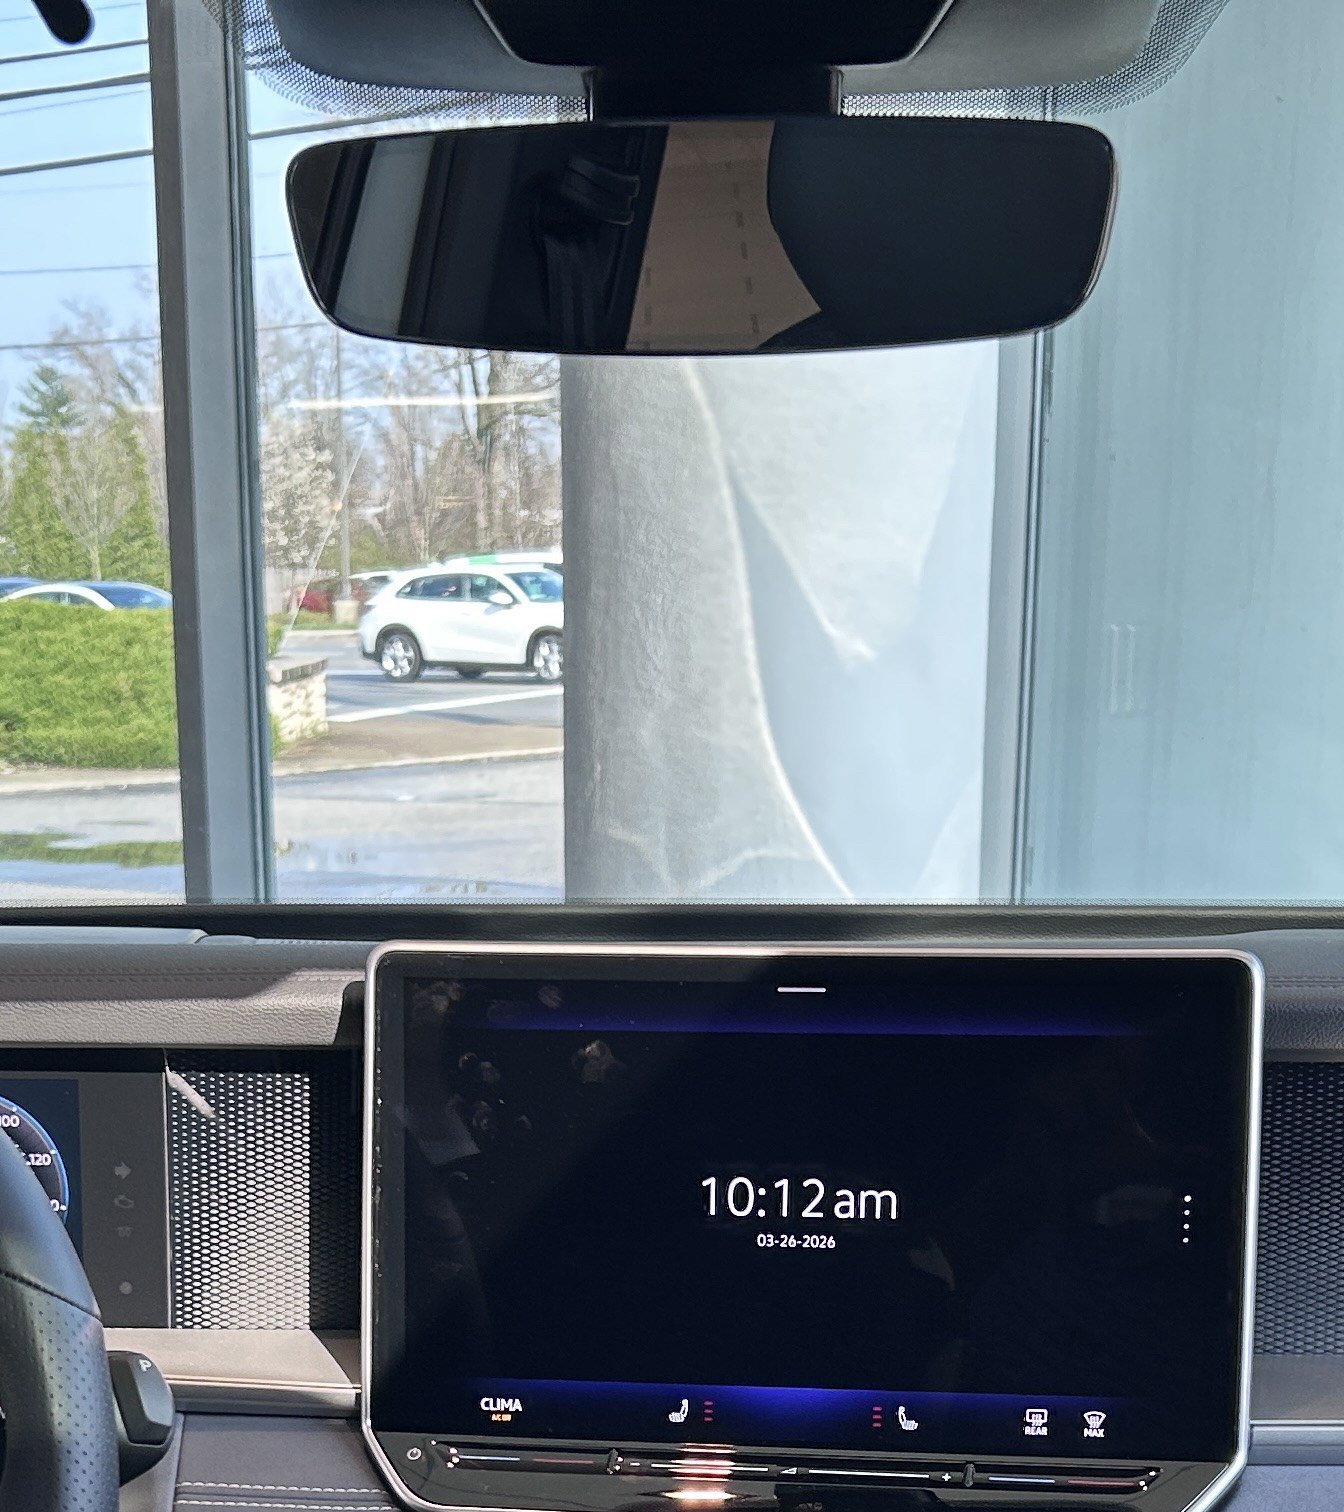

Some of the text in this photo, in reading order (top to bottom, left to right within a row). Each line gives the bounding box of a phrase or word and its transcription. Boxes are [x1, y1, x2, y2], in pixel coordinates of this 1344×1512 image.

[29, 1153, 52, 1166] 120
[701, 1176, 898, 1219] 10:12am
[756, 1233, 836, 1249] 03-26-2026
[480, 1397, 523, 1412] CLIMA
[1024, 1426, 1048, 1435] REAR
[1083, 1428, 1105, 1437] MAX
